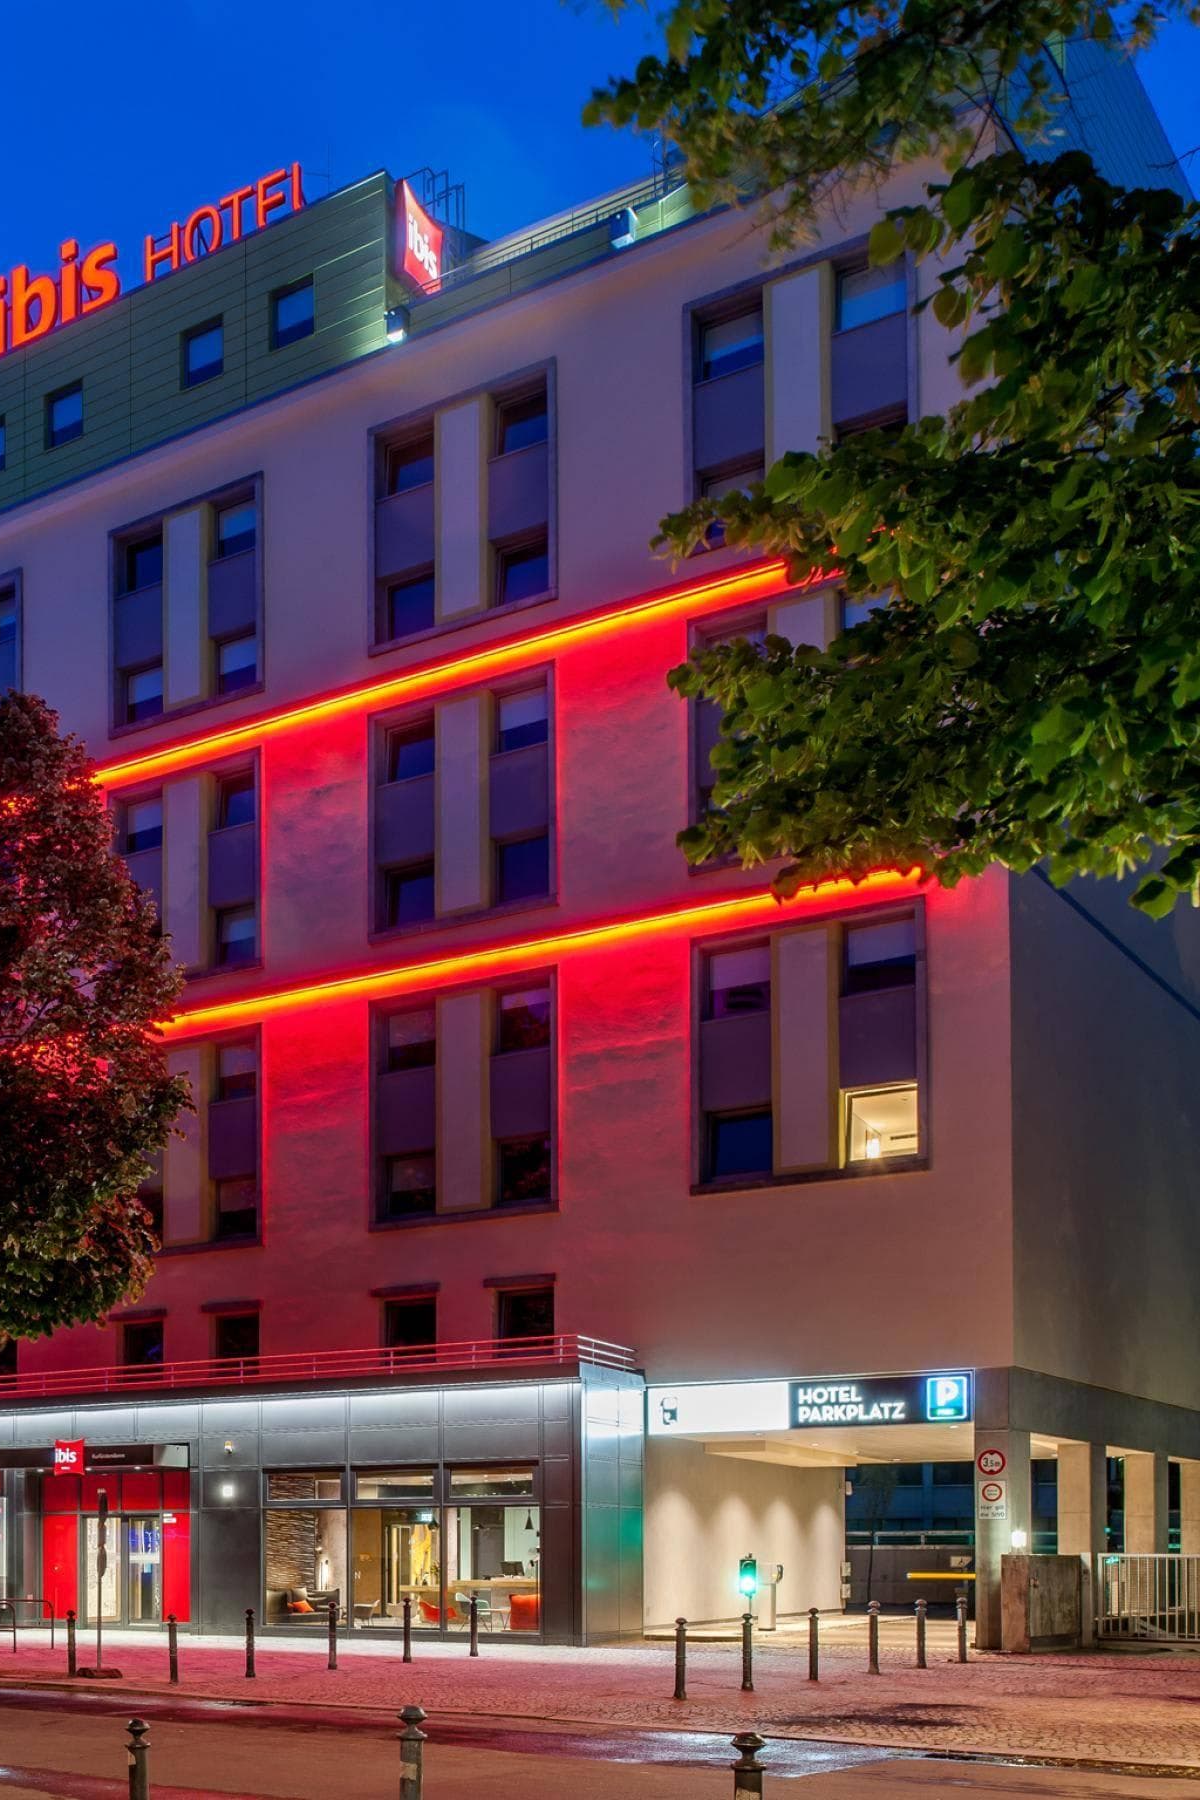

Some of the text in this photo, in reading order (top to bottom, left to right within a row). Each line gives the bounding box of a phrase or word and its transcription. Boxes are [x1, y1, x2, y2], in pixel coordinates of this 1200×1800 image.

[408, 213, 438, 280] ibis
[798, 1386, 862, 1404] HOTEL
[936, 1381, 960, 1407] P
[798, 1402, 906, 1423] PARKPLATZ
[54, 1448, 77, 1464] ibis
